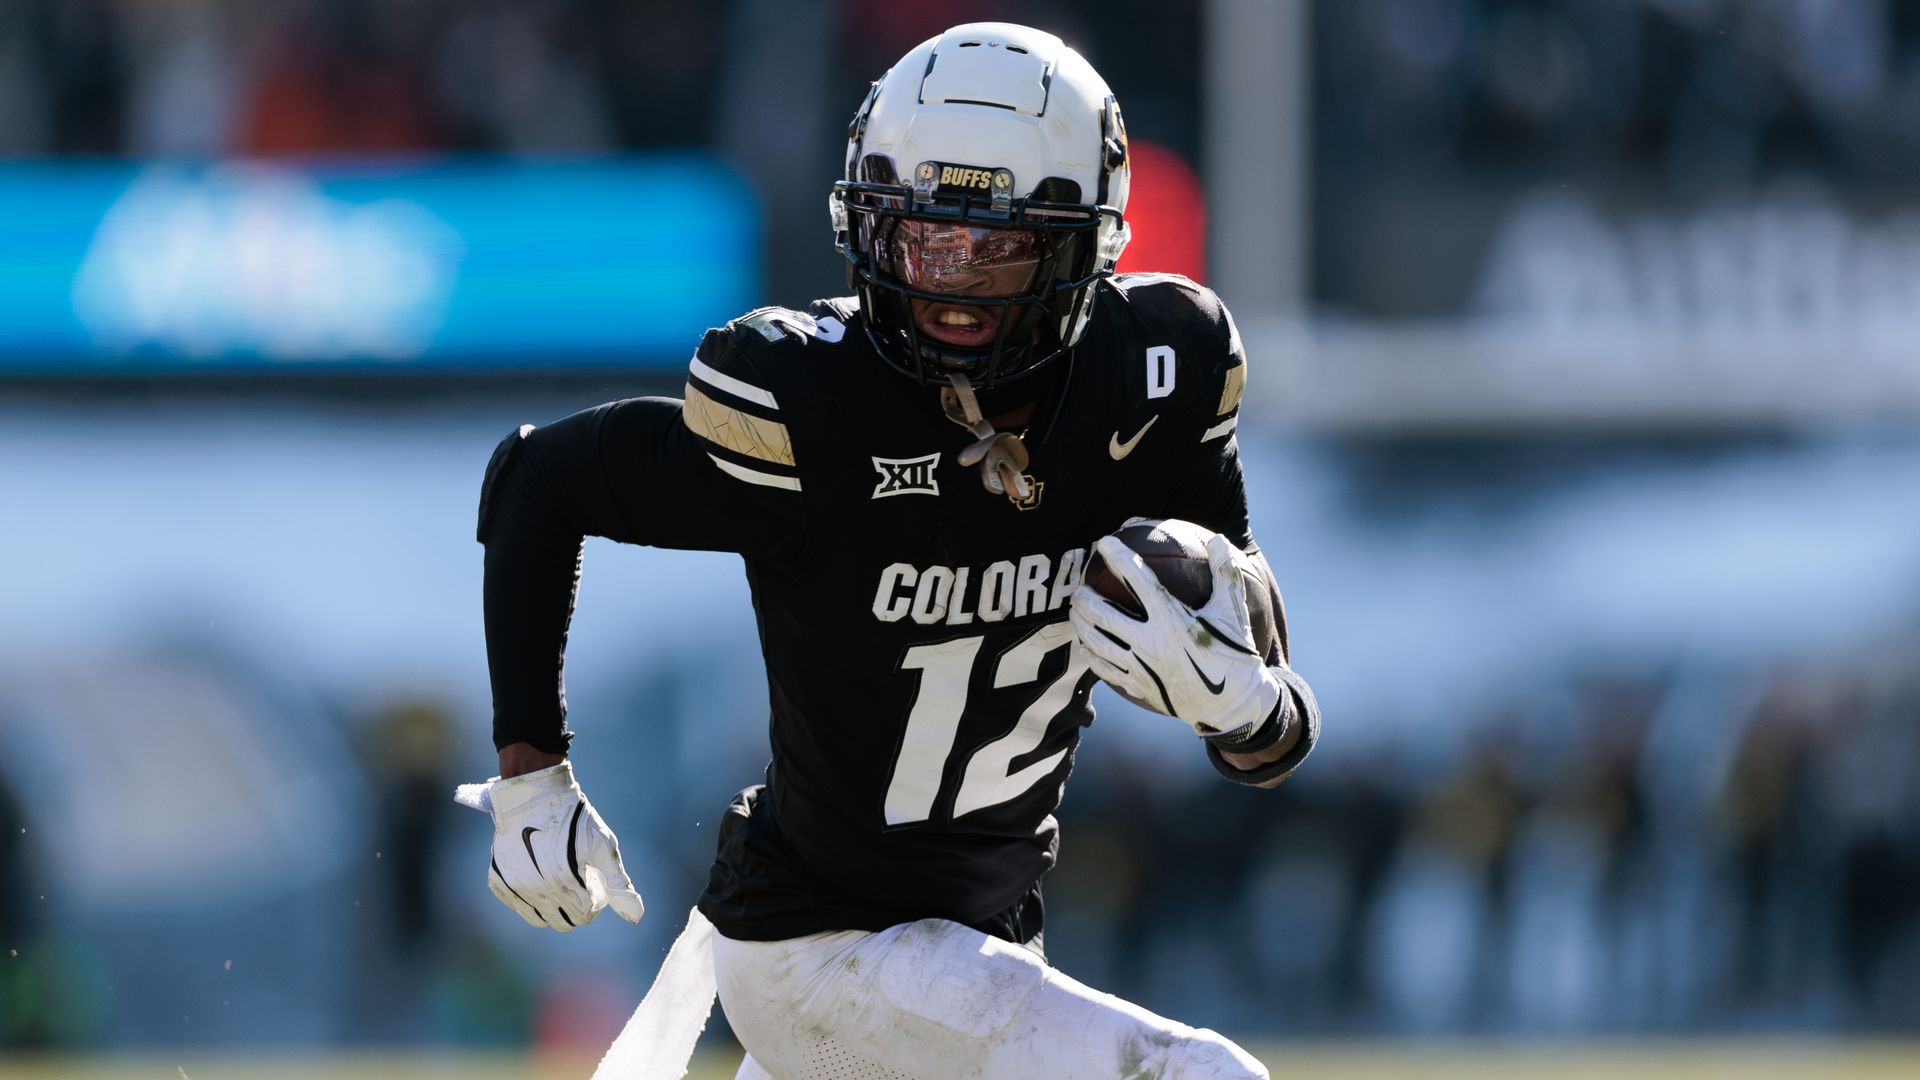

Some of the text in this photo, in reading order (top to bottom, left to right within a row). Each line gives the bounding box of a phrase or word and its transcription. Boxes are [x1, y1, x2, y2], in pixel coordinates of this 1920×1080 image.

[940, 166, 993, 189] BUFFS
[1145, 345, 1176, 400] D
[875, 458, 935, 496] XII
[872, 546, 1088, 626] COLORA
[884, 621, 1090, 827] 12
